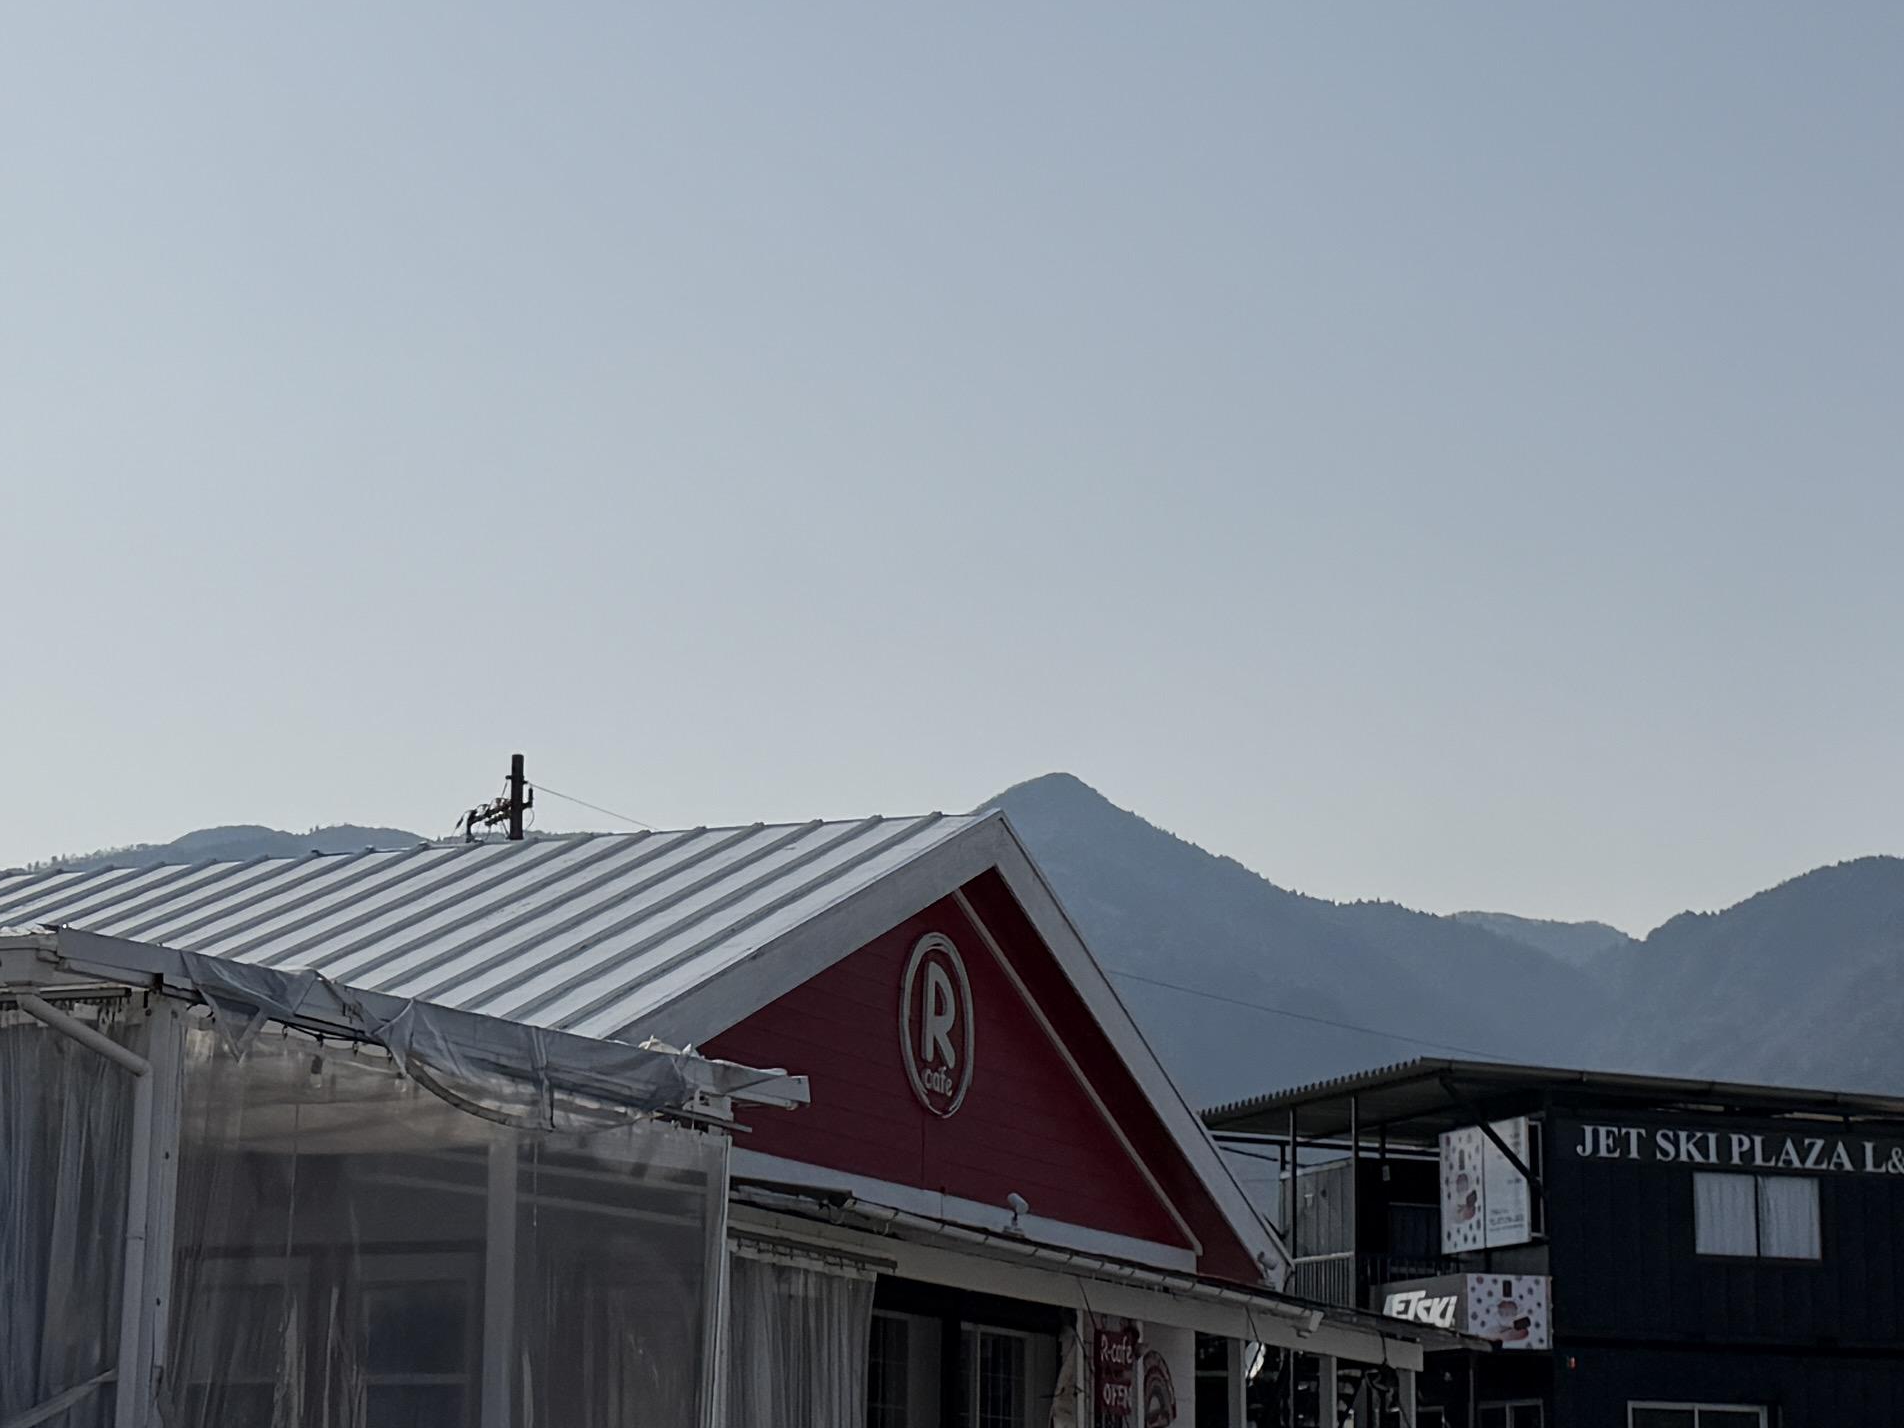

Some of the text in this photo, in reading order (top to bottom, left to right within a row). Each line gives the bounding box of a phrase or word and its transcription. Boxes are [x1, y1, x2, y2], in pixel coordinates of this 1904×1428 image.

[921, 961, 956, 1069] R
[922, 1066, 953, 1097] cafe
[1576, 1124, 1647, 1160] JET
[1655, 1128, 1720, 1164] SKI
[1728, 1132, 1855, 1172] PLAZA
